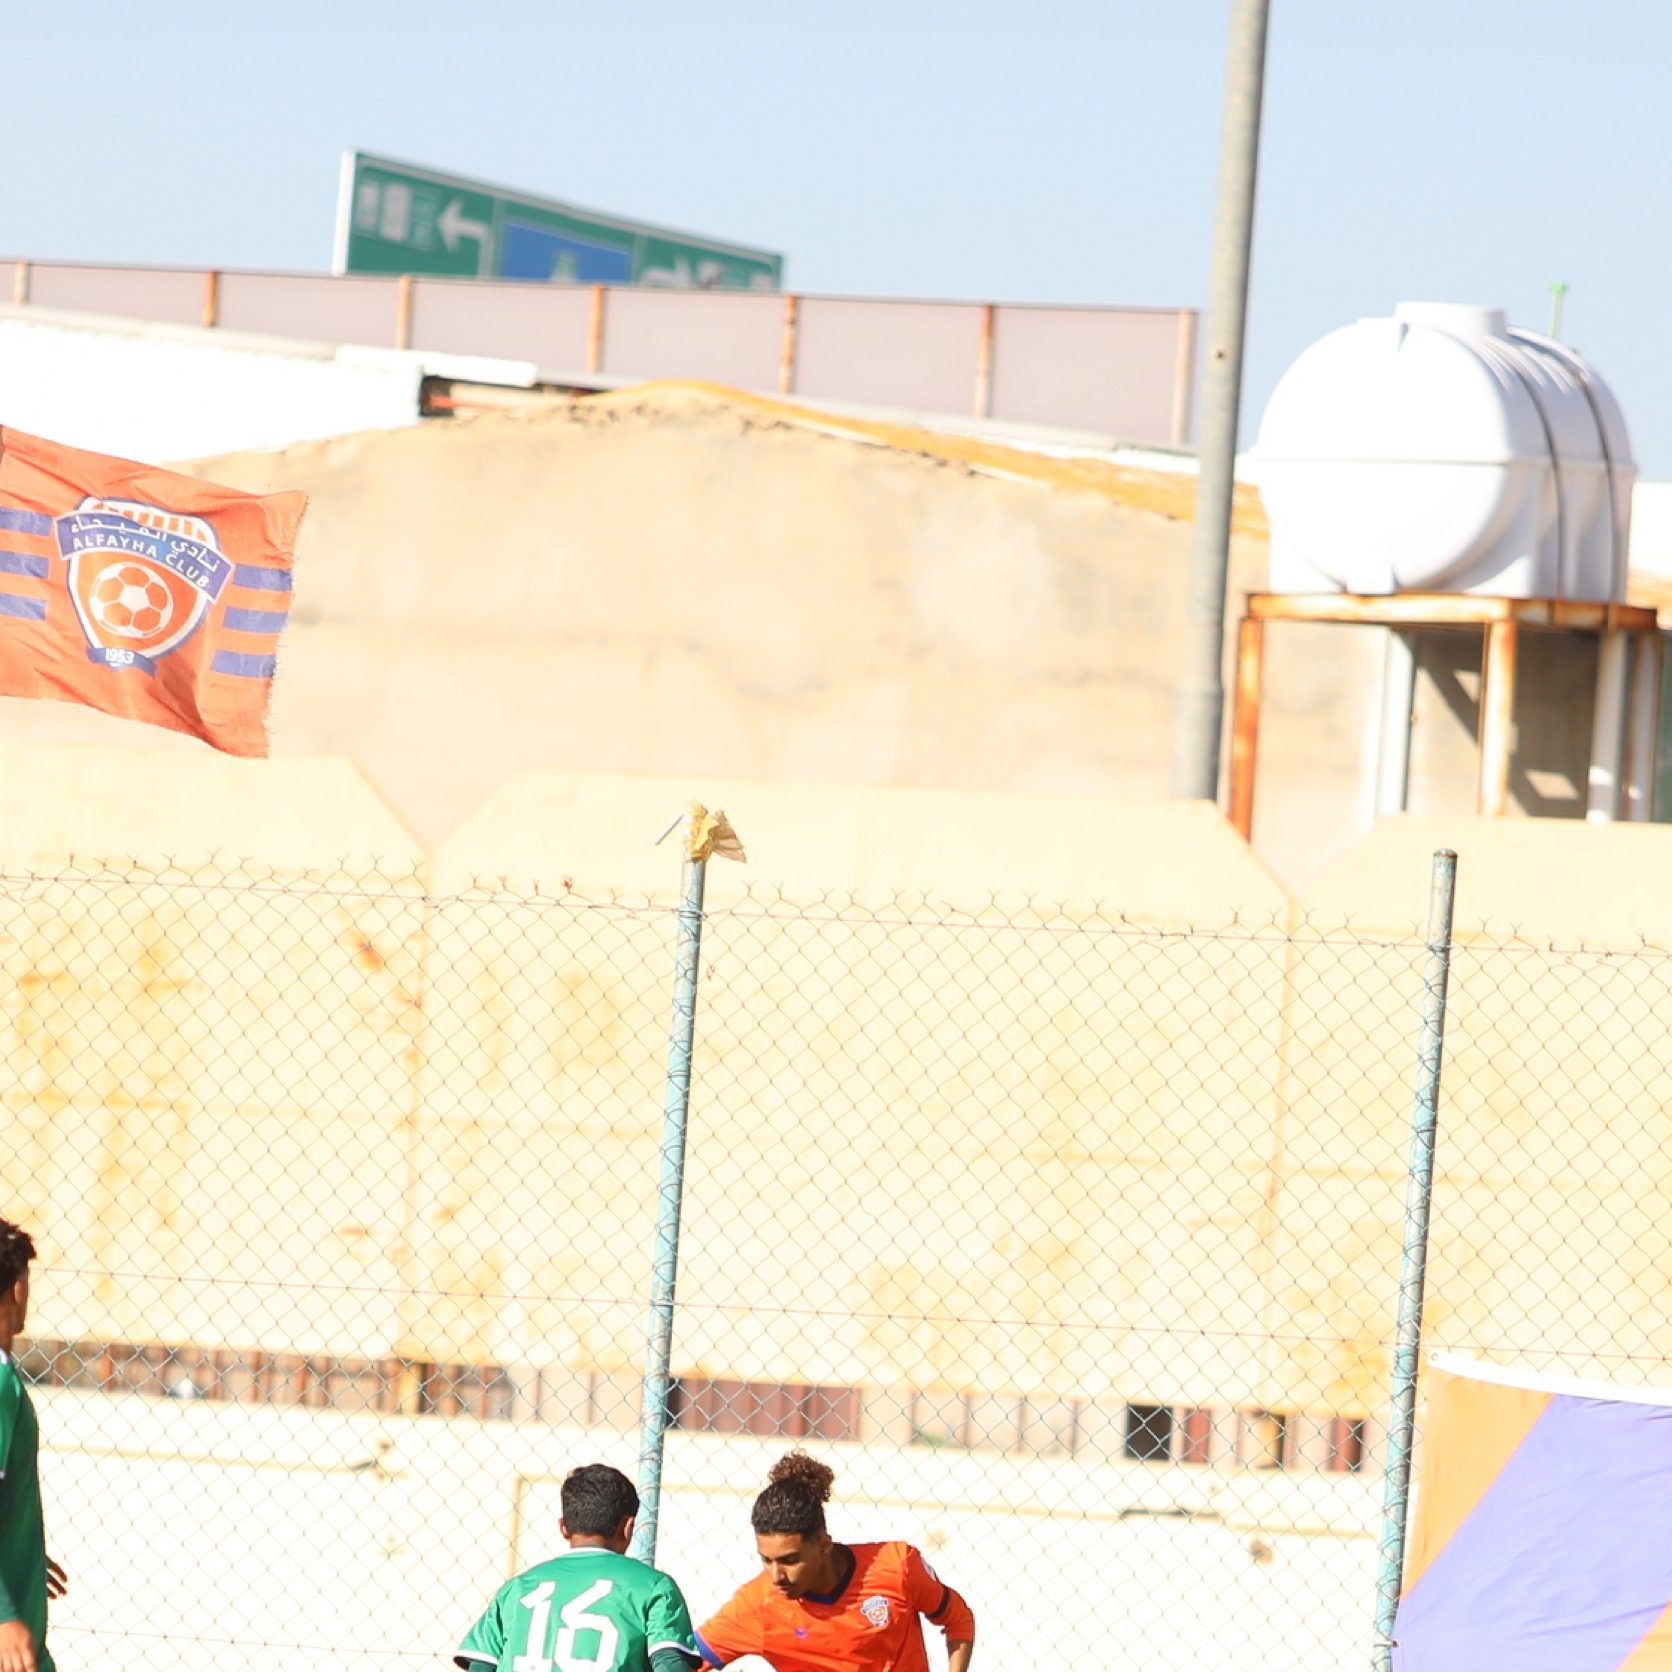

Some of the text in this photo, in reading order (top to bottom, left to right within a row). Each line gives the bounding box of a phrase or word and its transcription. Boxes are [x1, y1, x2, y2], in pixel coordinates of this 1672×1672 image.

[73, 535, 210, 588] ALFAYHA CLUB
[172, 540, 220, 572] نادي
[106, 648, 134, 664] 1953
